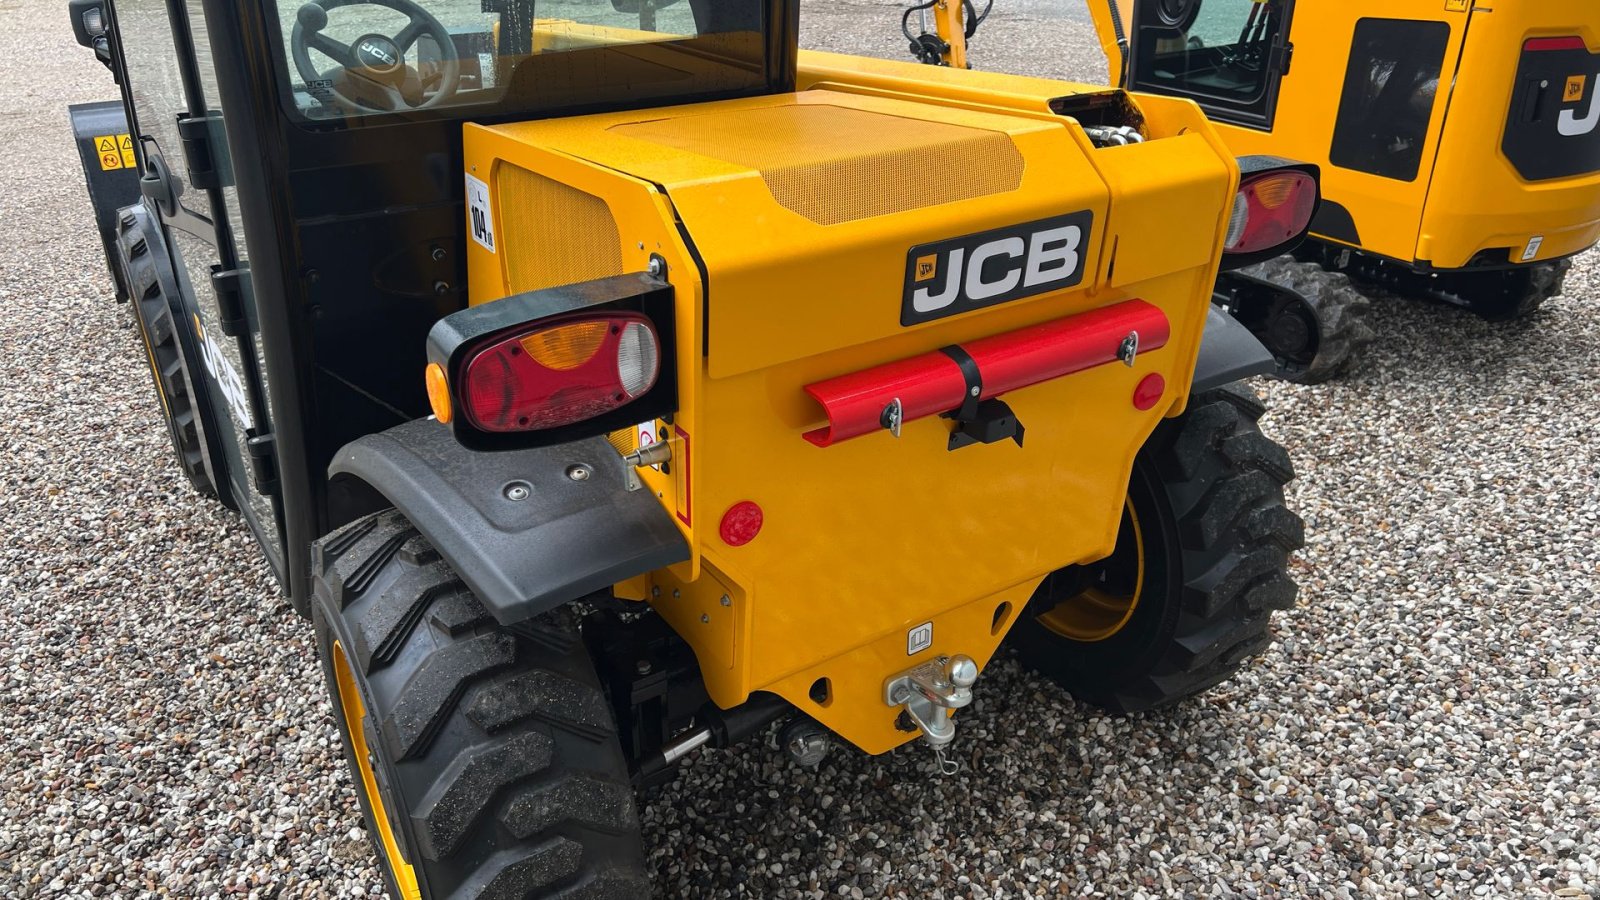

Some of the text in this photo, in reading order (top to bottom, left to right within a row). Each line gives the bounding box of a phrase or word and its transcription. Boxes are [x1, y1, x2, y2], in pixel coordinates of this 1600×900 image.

[361, 44, 396, 66] JCB
[306, 80, 332, 89] JCB
[471, 204, 488, 243] 104
[914, 225, 1081, 313] JCB
[200, 323, 252, 430] JCB
